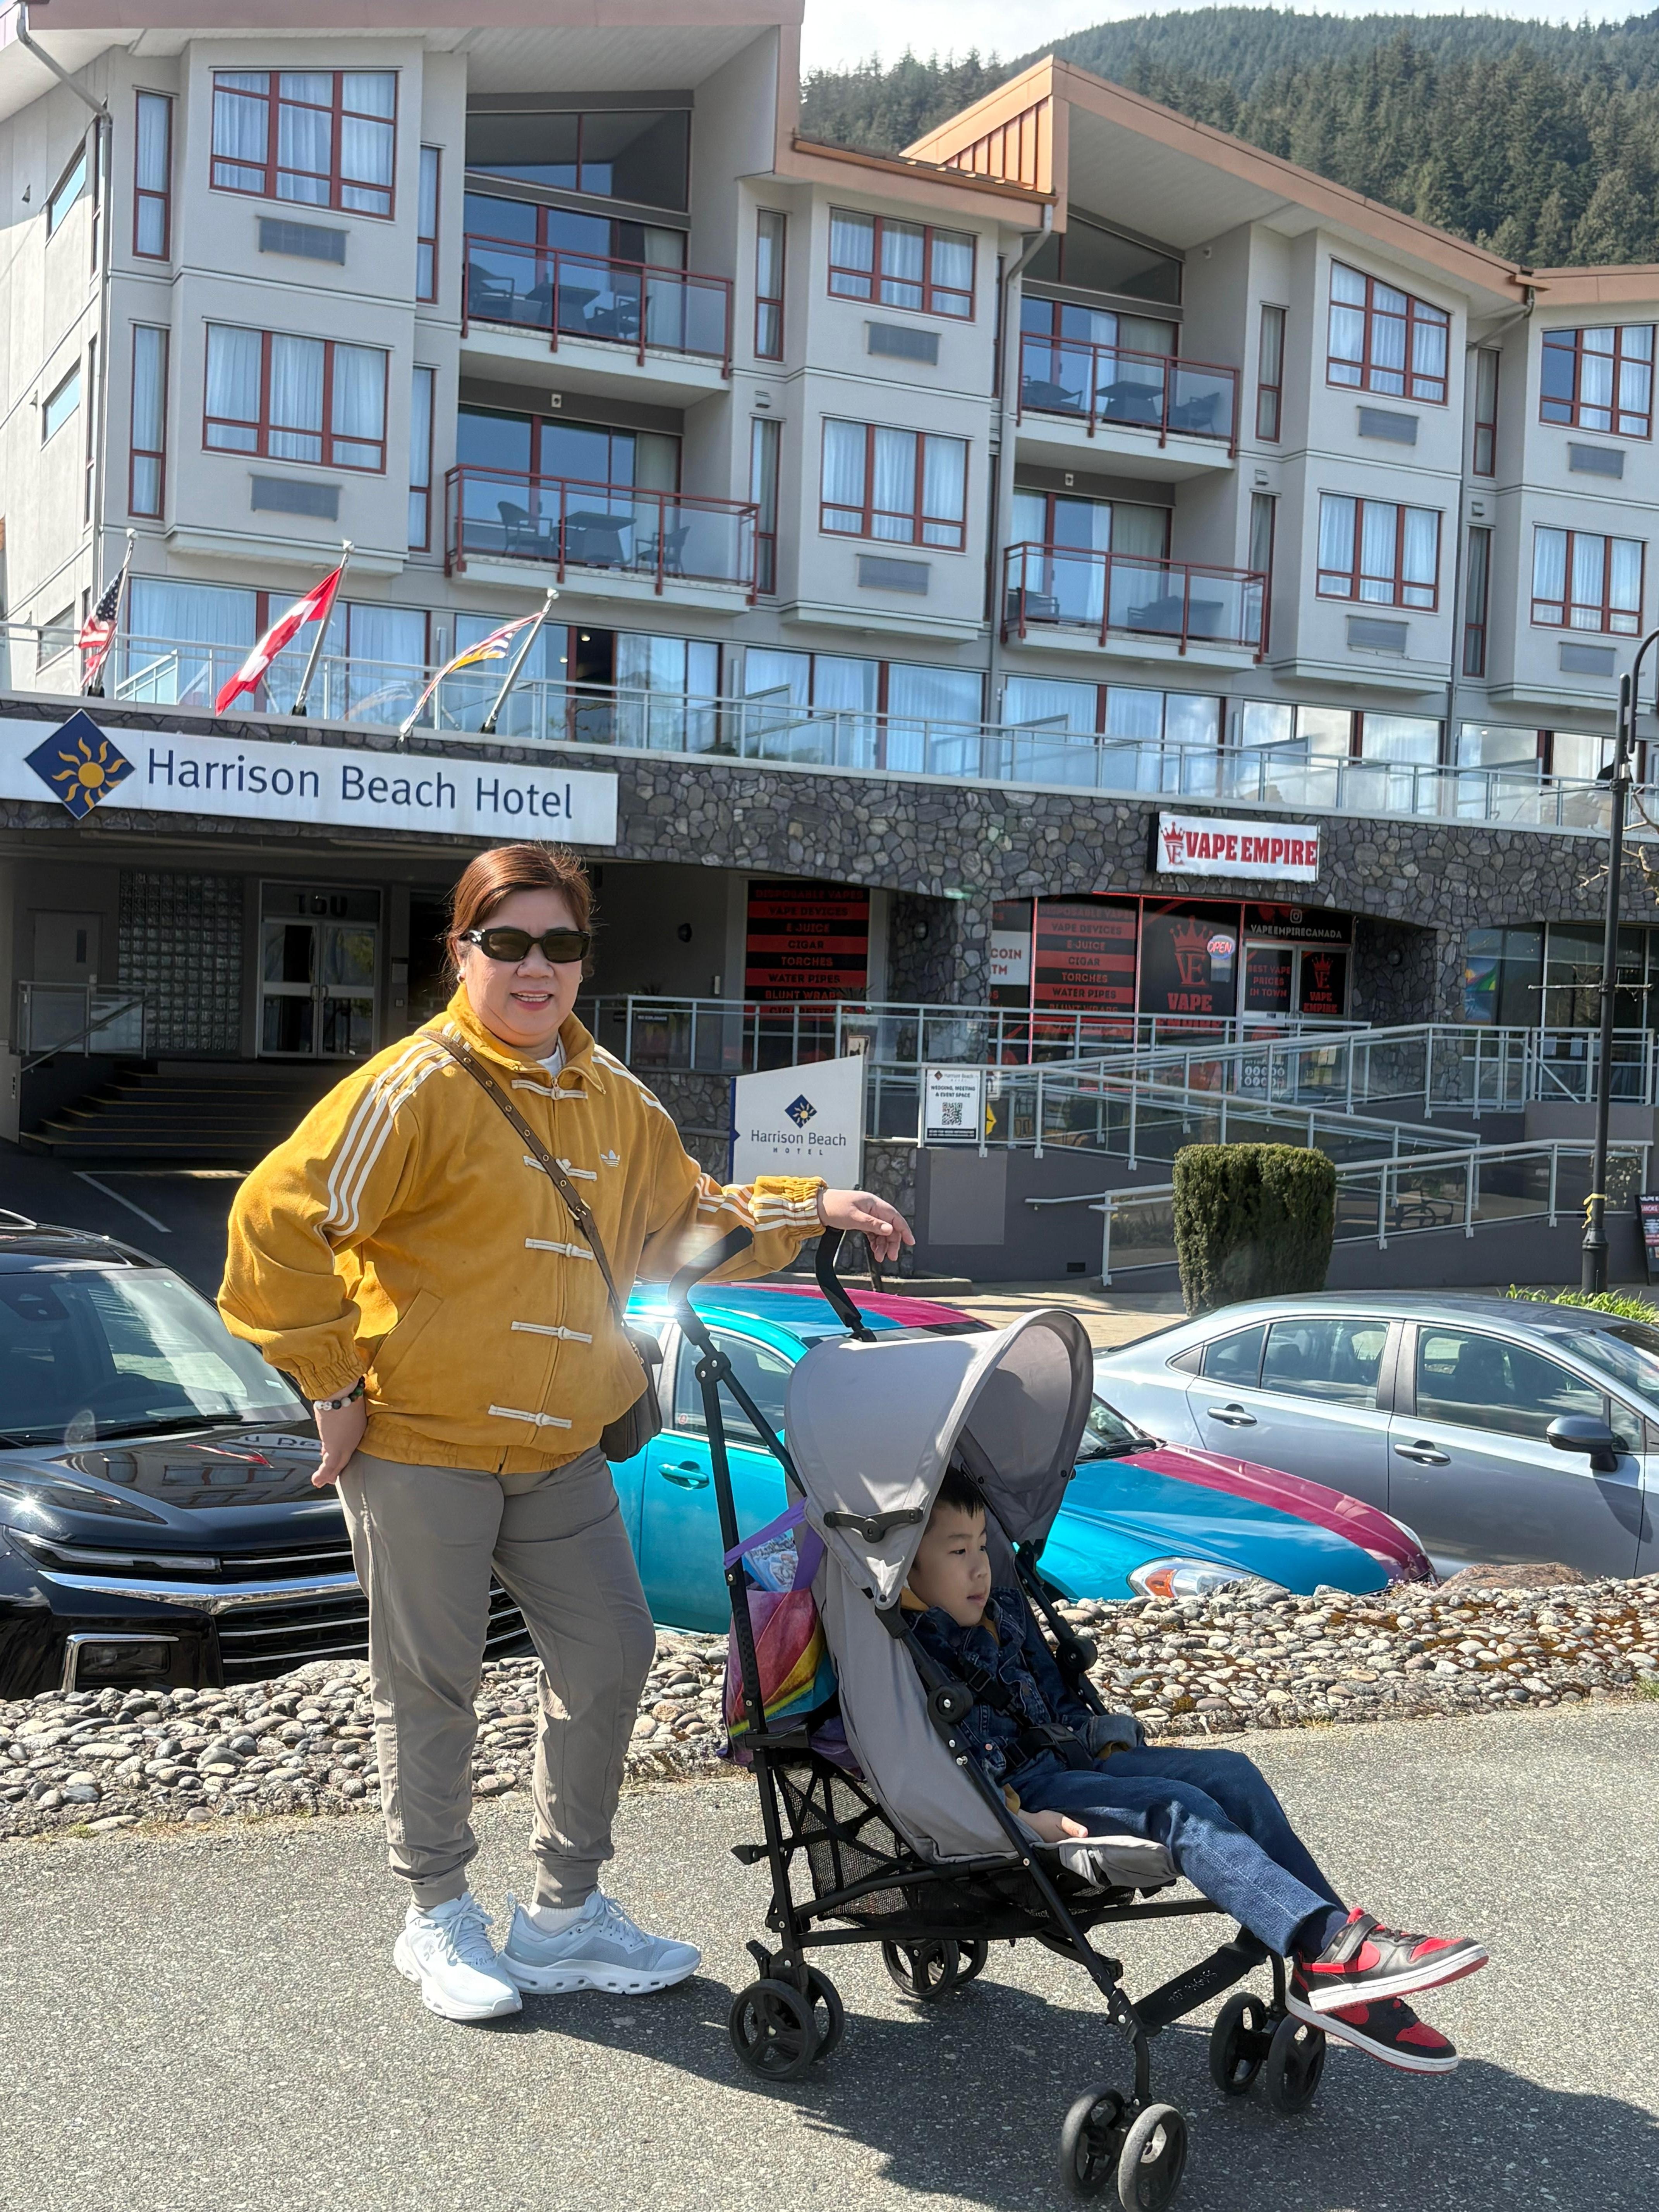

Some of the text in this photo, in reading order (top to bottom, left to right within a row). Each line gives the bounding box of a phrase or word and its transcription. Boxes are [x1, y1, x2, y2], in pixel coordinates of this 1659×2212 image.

[149, 748, 572, 819] Harrison Beach Hotel
[1186, 831, 1317, 866] VAPE EMPIRE
[769, 907, 848, 915] VAPE DEVICES
[795, 923, 830, 933] JUICE
[1052, 923, 1121, 934] VAPE DEVICES
[1250, 924, 1342, 939] VAPEEMPIRECANADA
[788, 940, 824, 949] CIGAR
[1075, 940, 1106, 951] JUICE
[1207, 941, 1232, 954] OPEN
[781, 957, 833, 967] TORCHES
[1068, 957, 1100, 966] CIGAR
[991, 964, 1008, 975] TM
[1247, 964, 1291, 975] BEST VAPE
[768, 974, 840, 983] WATER PIPES
[1061, 972, 1108, 983] TORCHES
[1253, 977, 1285, 986] PRICES
[765, 990, 801, 1000] BLUNT
[1053, 988, 1116, 999] WATER PIPES
[1263, 989, 1287, 997] TOWN
[1309, 991, 1332, 1002] VAPE
[1167, 992, 1212, 1012] VAPE
[1303, 1002, 1338, 1013] EMPIRE
[751, 1130, 846, 1146] Harrison Beach
